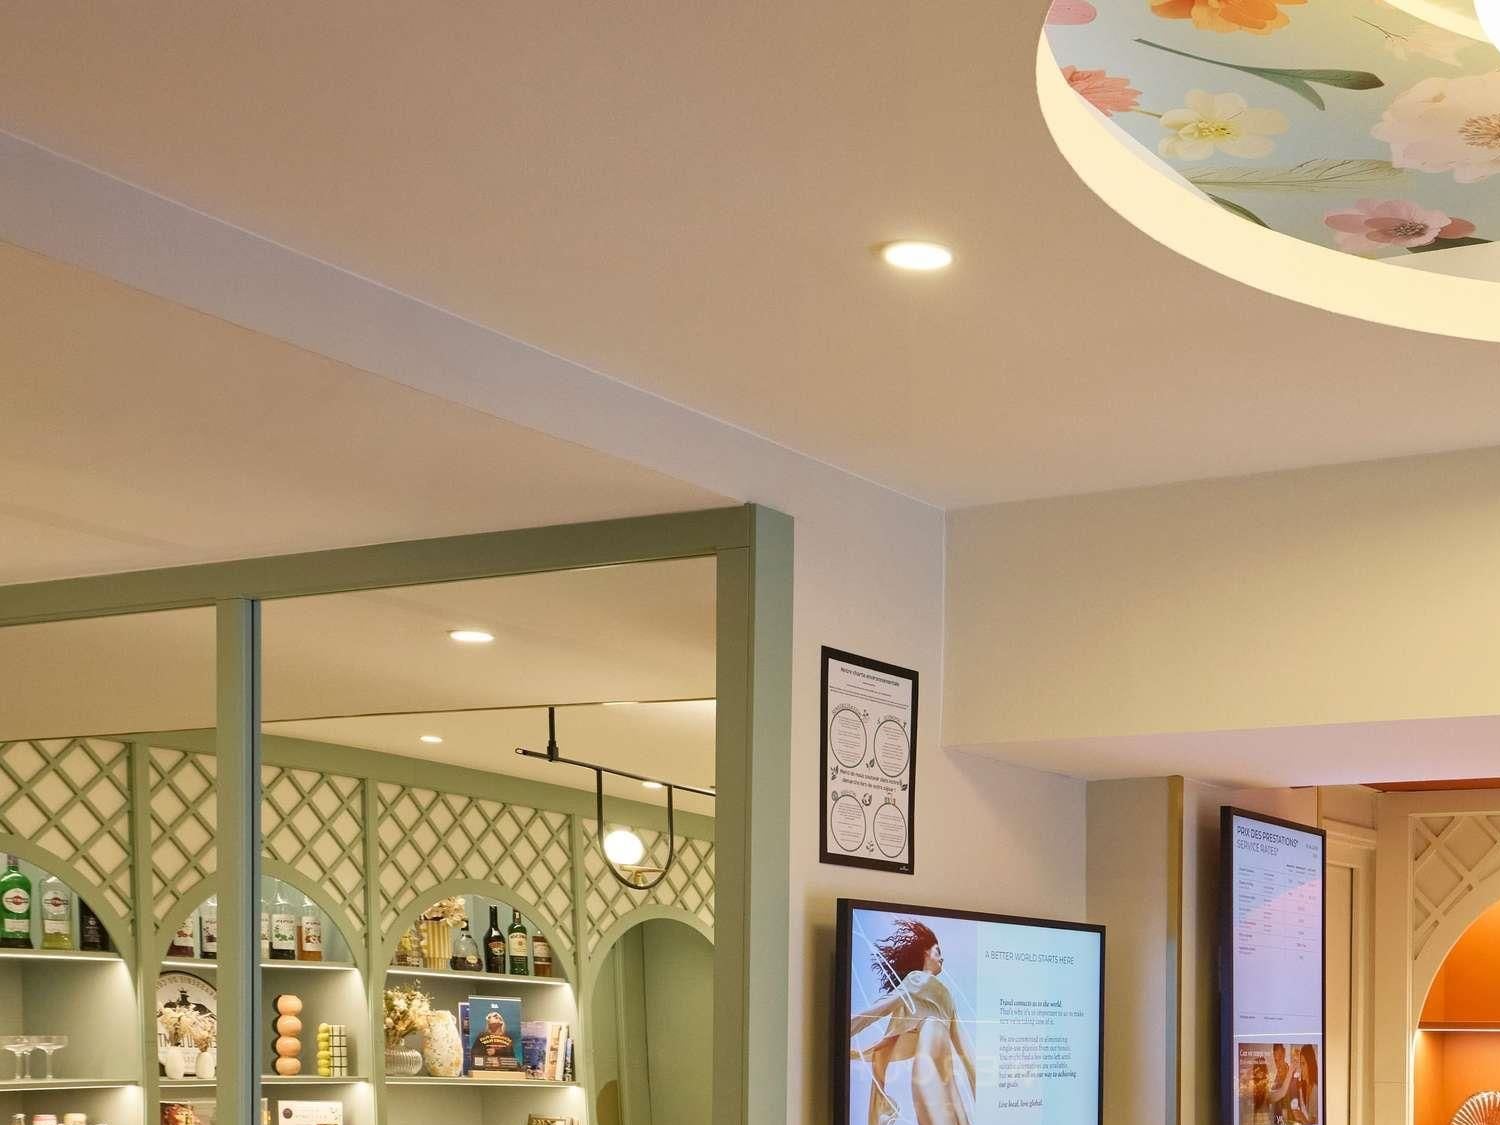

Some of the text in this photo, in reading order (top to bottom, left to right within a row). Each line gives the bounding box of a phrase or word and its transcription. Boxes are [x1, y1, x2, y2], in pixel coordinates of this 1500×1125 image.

[1237, 825, 1250, 836] PRIX
[1250, 828, 1262, 840] DES
[1236, 839, 1259, 853] SERVICE
[991, 950, 1014, 961] BETTER
[1014, 952, 1038, 962] WORLD
[1038, 954, 1059, 964] STARTS
[1059, 955, 1075, 965] HERE
